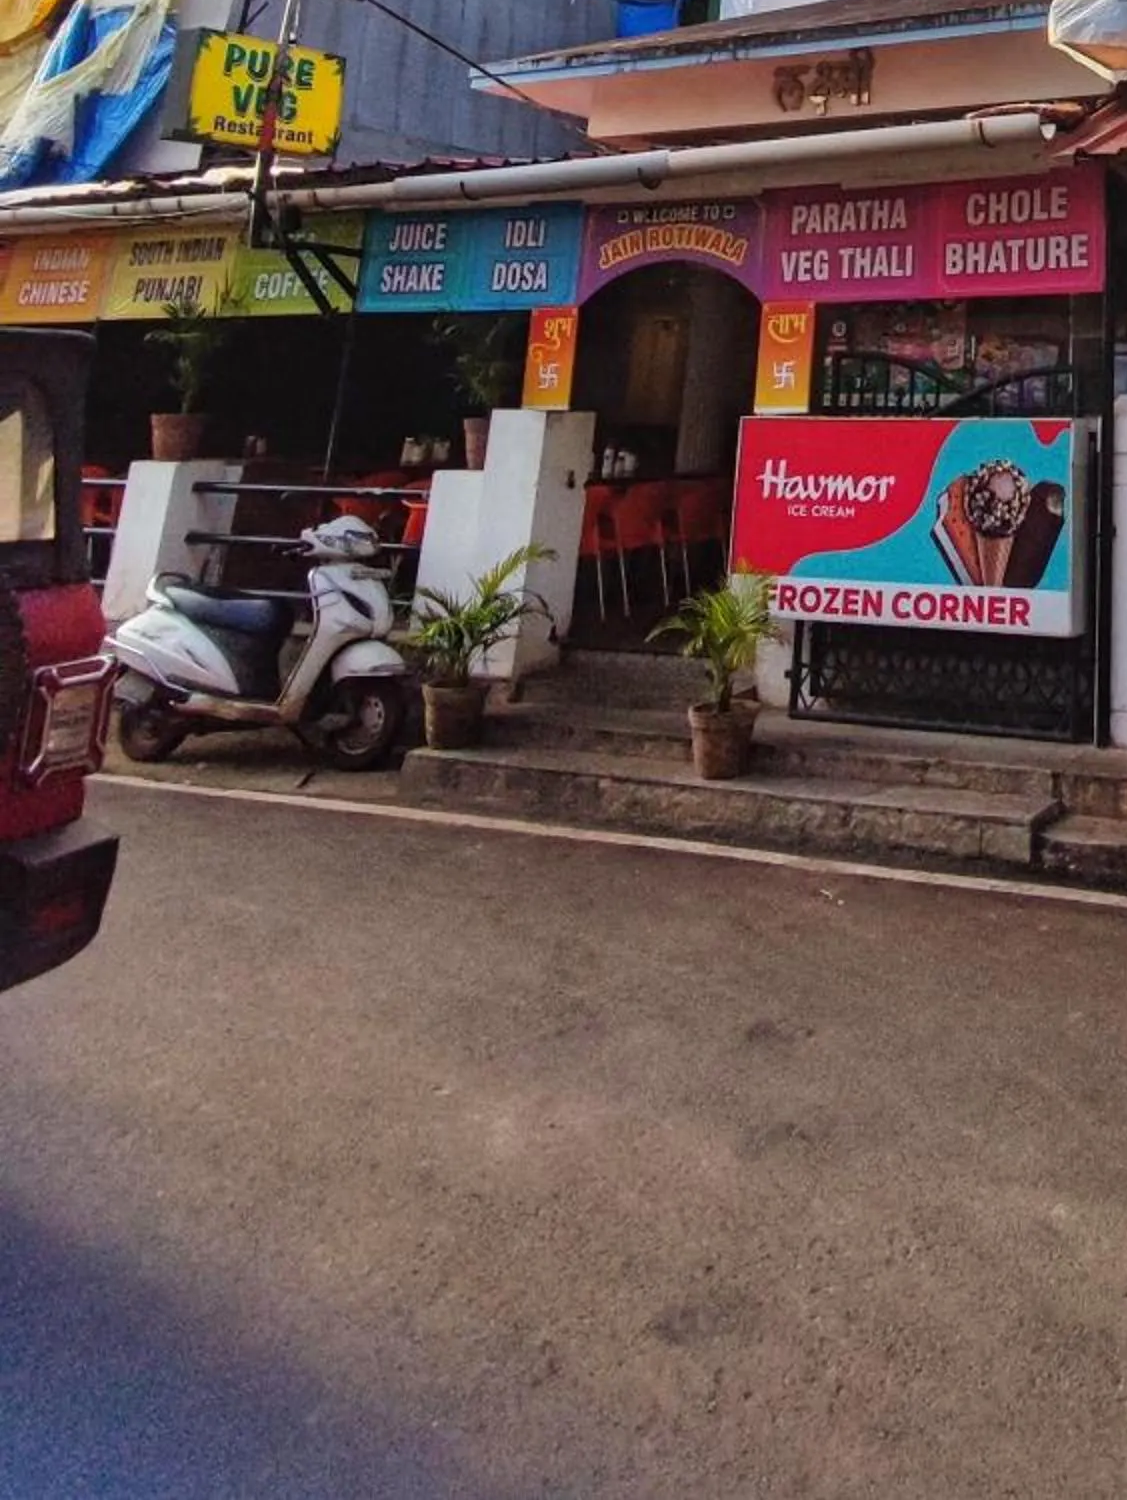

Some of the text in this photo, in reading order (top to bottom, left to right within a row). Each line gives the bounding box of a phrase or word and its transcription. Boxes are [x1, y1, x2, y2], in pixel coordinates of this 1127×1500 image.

[213, 116, 314, 145] Restarant
[633, 204, 720, 223] WELCOME TO
[790, 198, 907, 236] PARATHA
[966, 186, 1068, 226] CHOLE
[389, 222, 448, 251] JUICE
[504, 219, 547, 249] IDLI
[599, 223, 749, 269] JAIN ROTIWALA
[33, 248, 90, 272] INDIAN
[129, 238, 226, 266] SOUTH INDIAN
[781, 245, 914, 283] VEG THALI
[945, 234, 1089, 276] BHATURE
[132, 276, 204, 303] PUNJABI
[254, 269, 330, 300] COFFE
[380, 264, 445, 293] SHAKE
[491, 261, 549, 292] DOSA
[18, 280, 91, 305] CHINESE
[543, 316, 575, 351] शुभ
[767, 314, 809, 344] लाभ
[757, 458, 896, 503] Havmor
[787, 504, 856, 518] ICE CREAM
[891, 591, 1030, 627] CORNER
